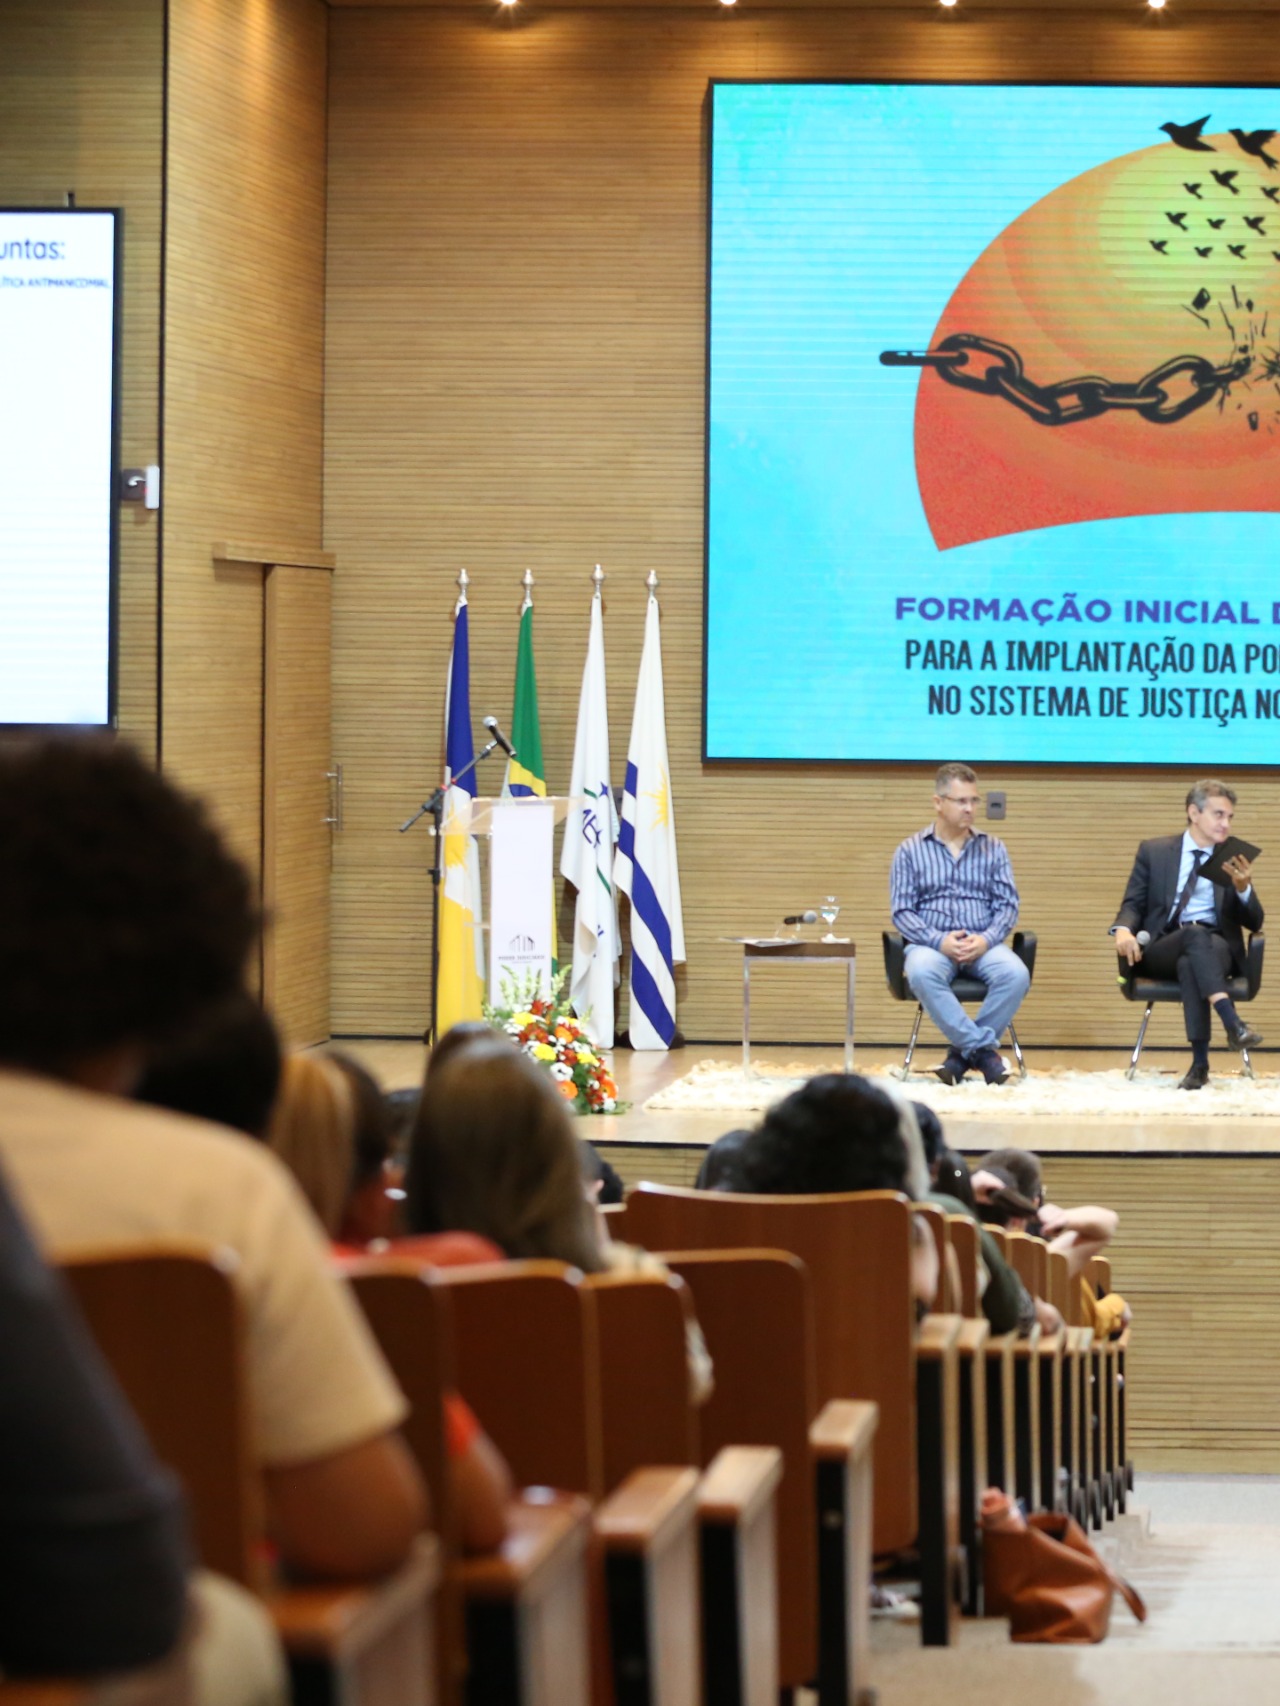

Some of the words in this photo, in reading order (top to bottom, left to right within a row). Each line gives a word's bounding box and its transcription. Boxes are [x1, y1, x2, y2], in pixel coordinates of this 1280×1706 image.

[895, 593, 1112, 626] FORMAÇÃO
[1124, 600, 1260, 625] INICIAL
[904, 639, 973, 671] PARA
[980, 640, 997, 671] A
[1006, 636, 1195, 681] IMPLANTAÇÃO
[1203, 643, 1237, 674] DA
[928, 685, 962, 716] NO
[969, 685, 1092, 717] SISTEMA
[1100, 687, 1129, 718] DE
[1138, 687, 1248, 727] JUSTIÇA
